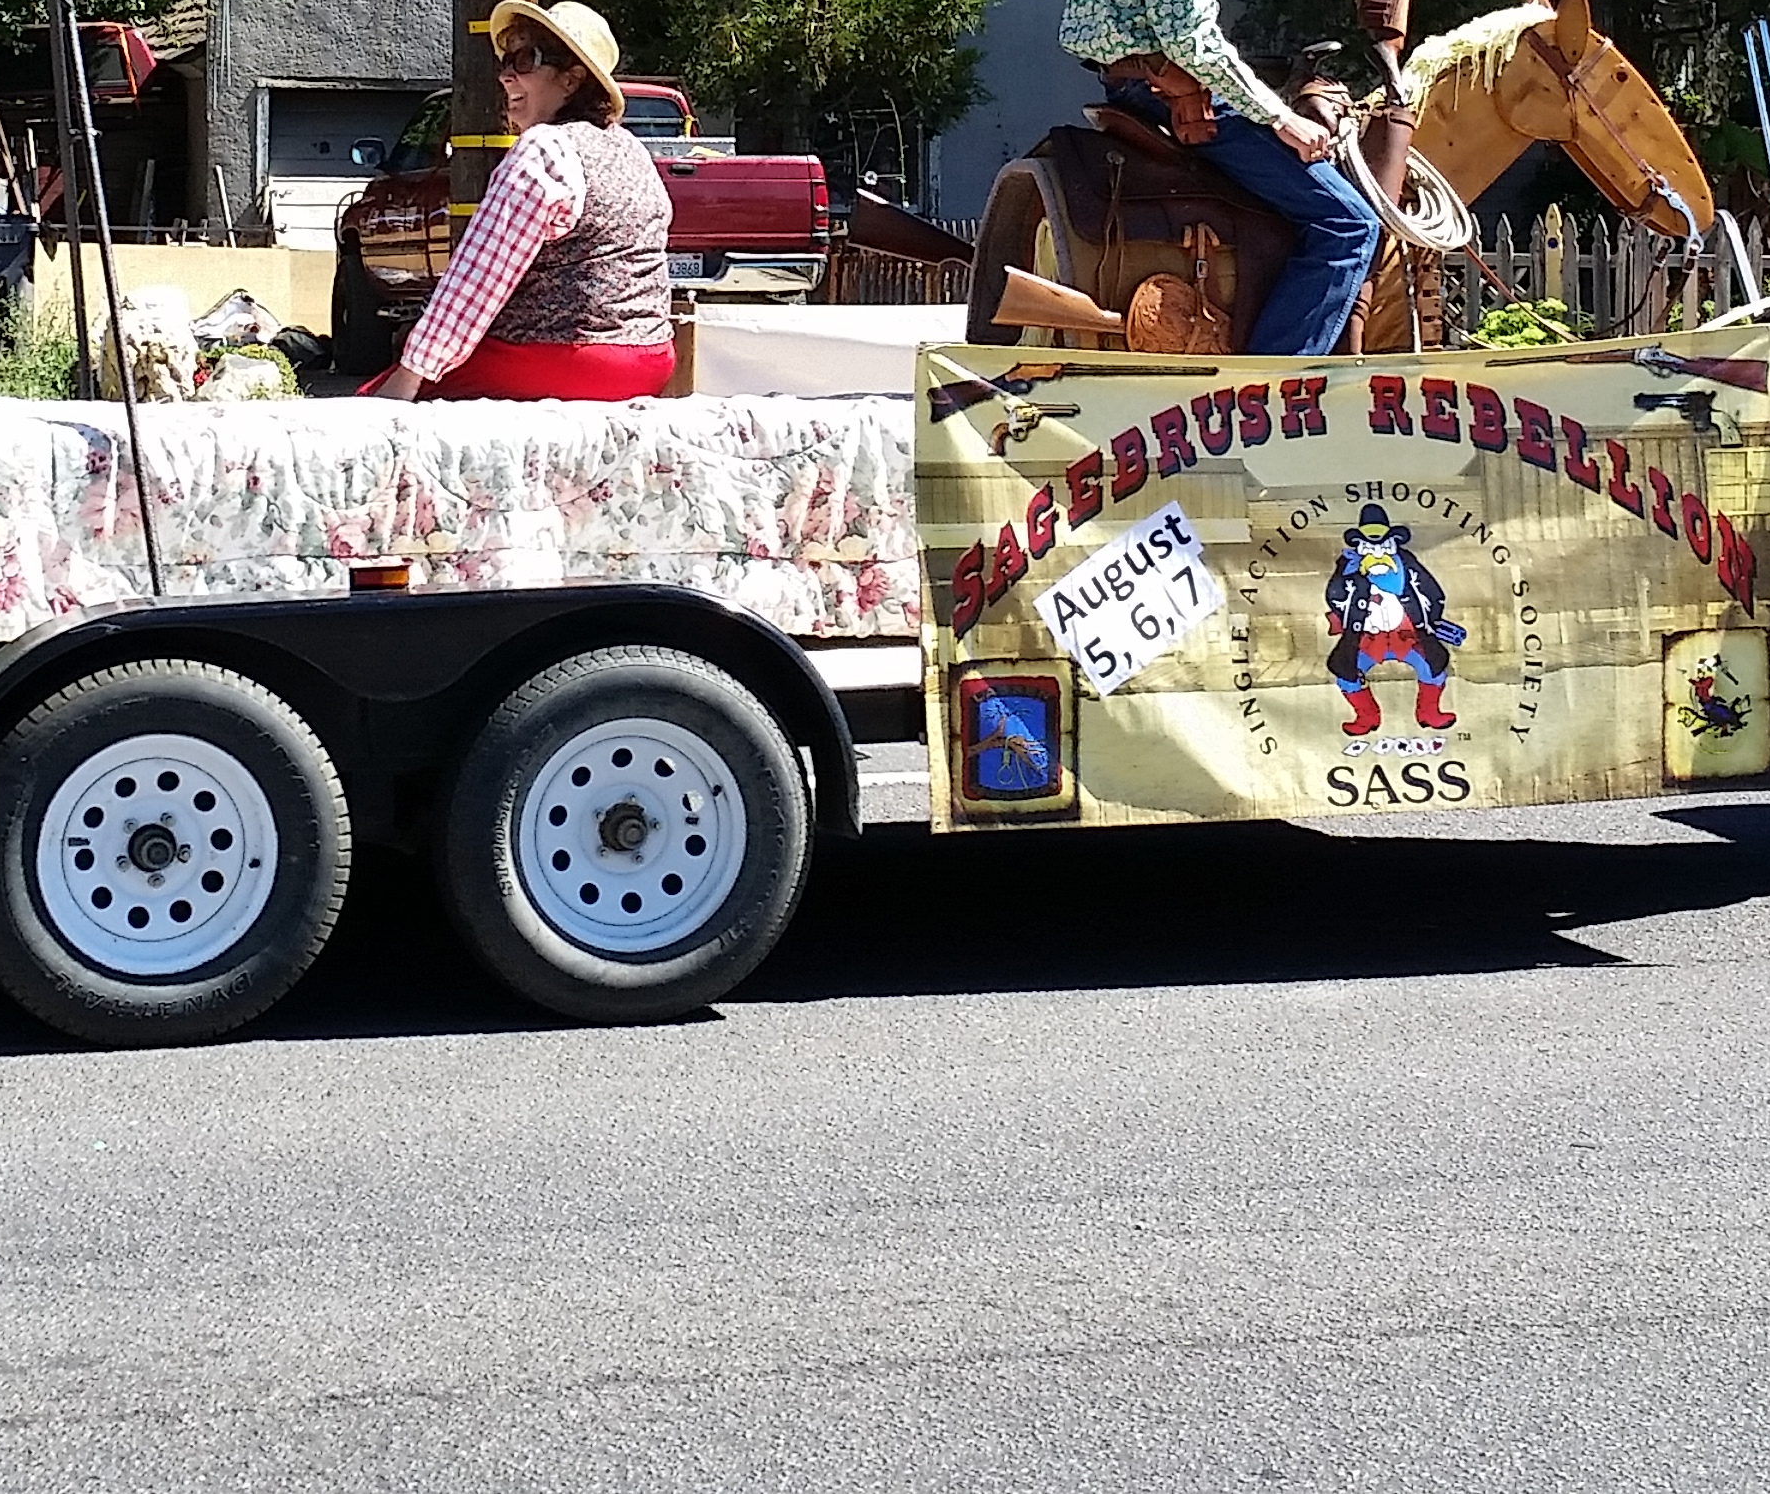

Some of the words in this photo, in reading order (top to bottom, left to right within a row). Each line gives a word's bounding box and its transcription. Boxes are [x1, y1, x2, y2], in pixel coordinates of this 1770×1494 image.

[952, 376, 1328, 640] SAGEBRUSH
[1368, 374, 1757, 620] REBELLION
[1239, 495, 1330, 605] ACTION
[1345, 480, 1511, 565] SHOOTING
[1052, 514, 1192, 635] August
[1084, 637, 1133, 679] 5,
[1130, 602, 1175, 640] 6,
[1171, 565, 1199, 606] 7
[1231, 625, 1277, 755] SINGLE
[1510, 579, 1544, 744] SOCIETY
[1327, 760, 1471, 807] SASS
